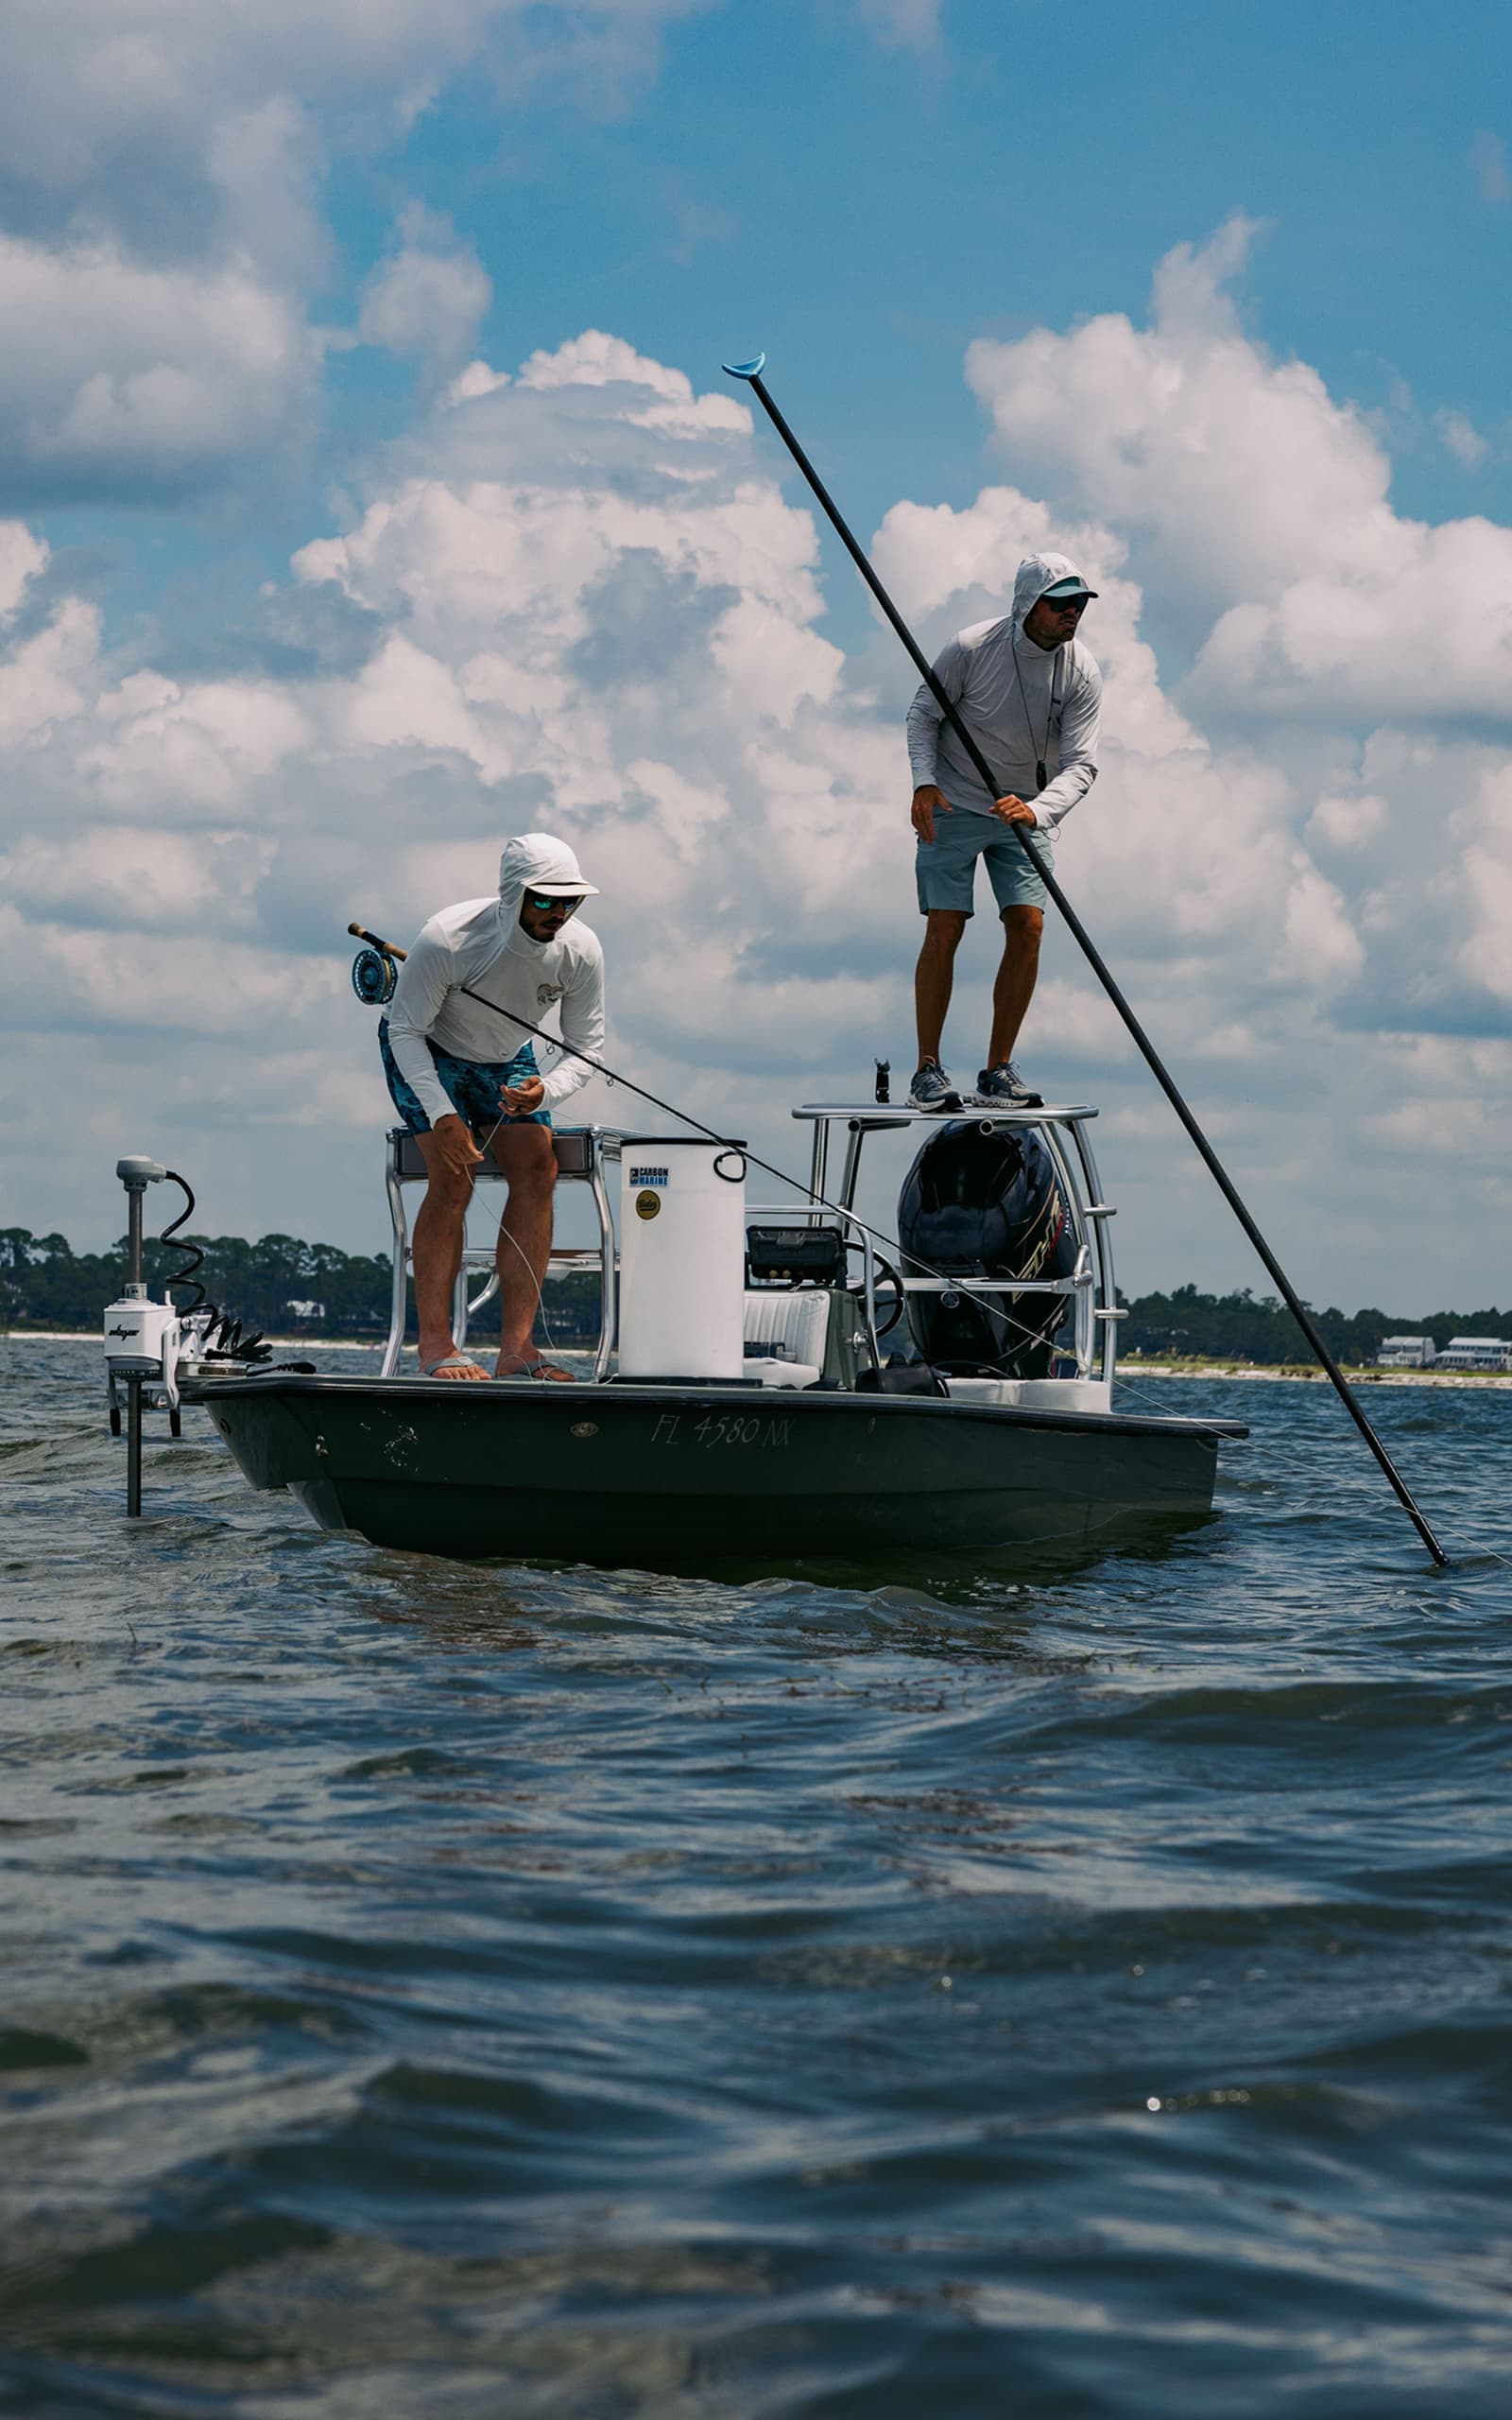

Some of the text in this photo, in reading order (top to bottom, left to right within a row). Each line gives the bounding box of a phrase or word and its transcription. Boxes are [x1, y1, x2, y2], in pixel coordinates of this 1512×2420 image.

[640, 1167, 668, 1176] CARBON
[640, 1176, 667, 1185] MARINE
[651, 1414, 681, 1444] FL
[694, 1416, 760, 1448] 4580
